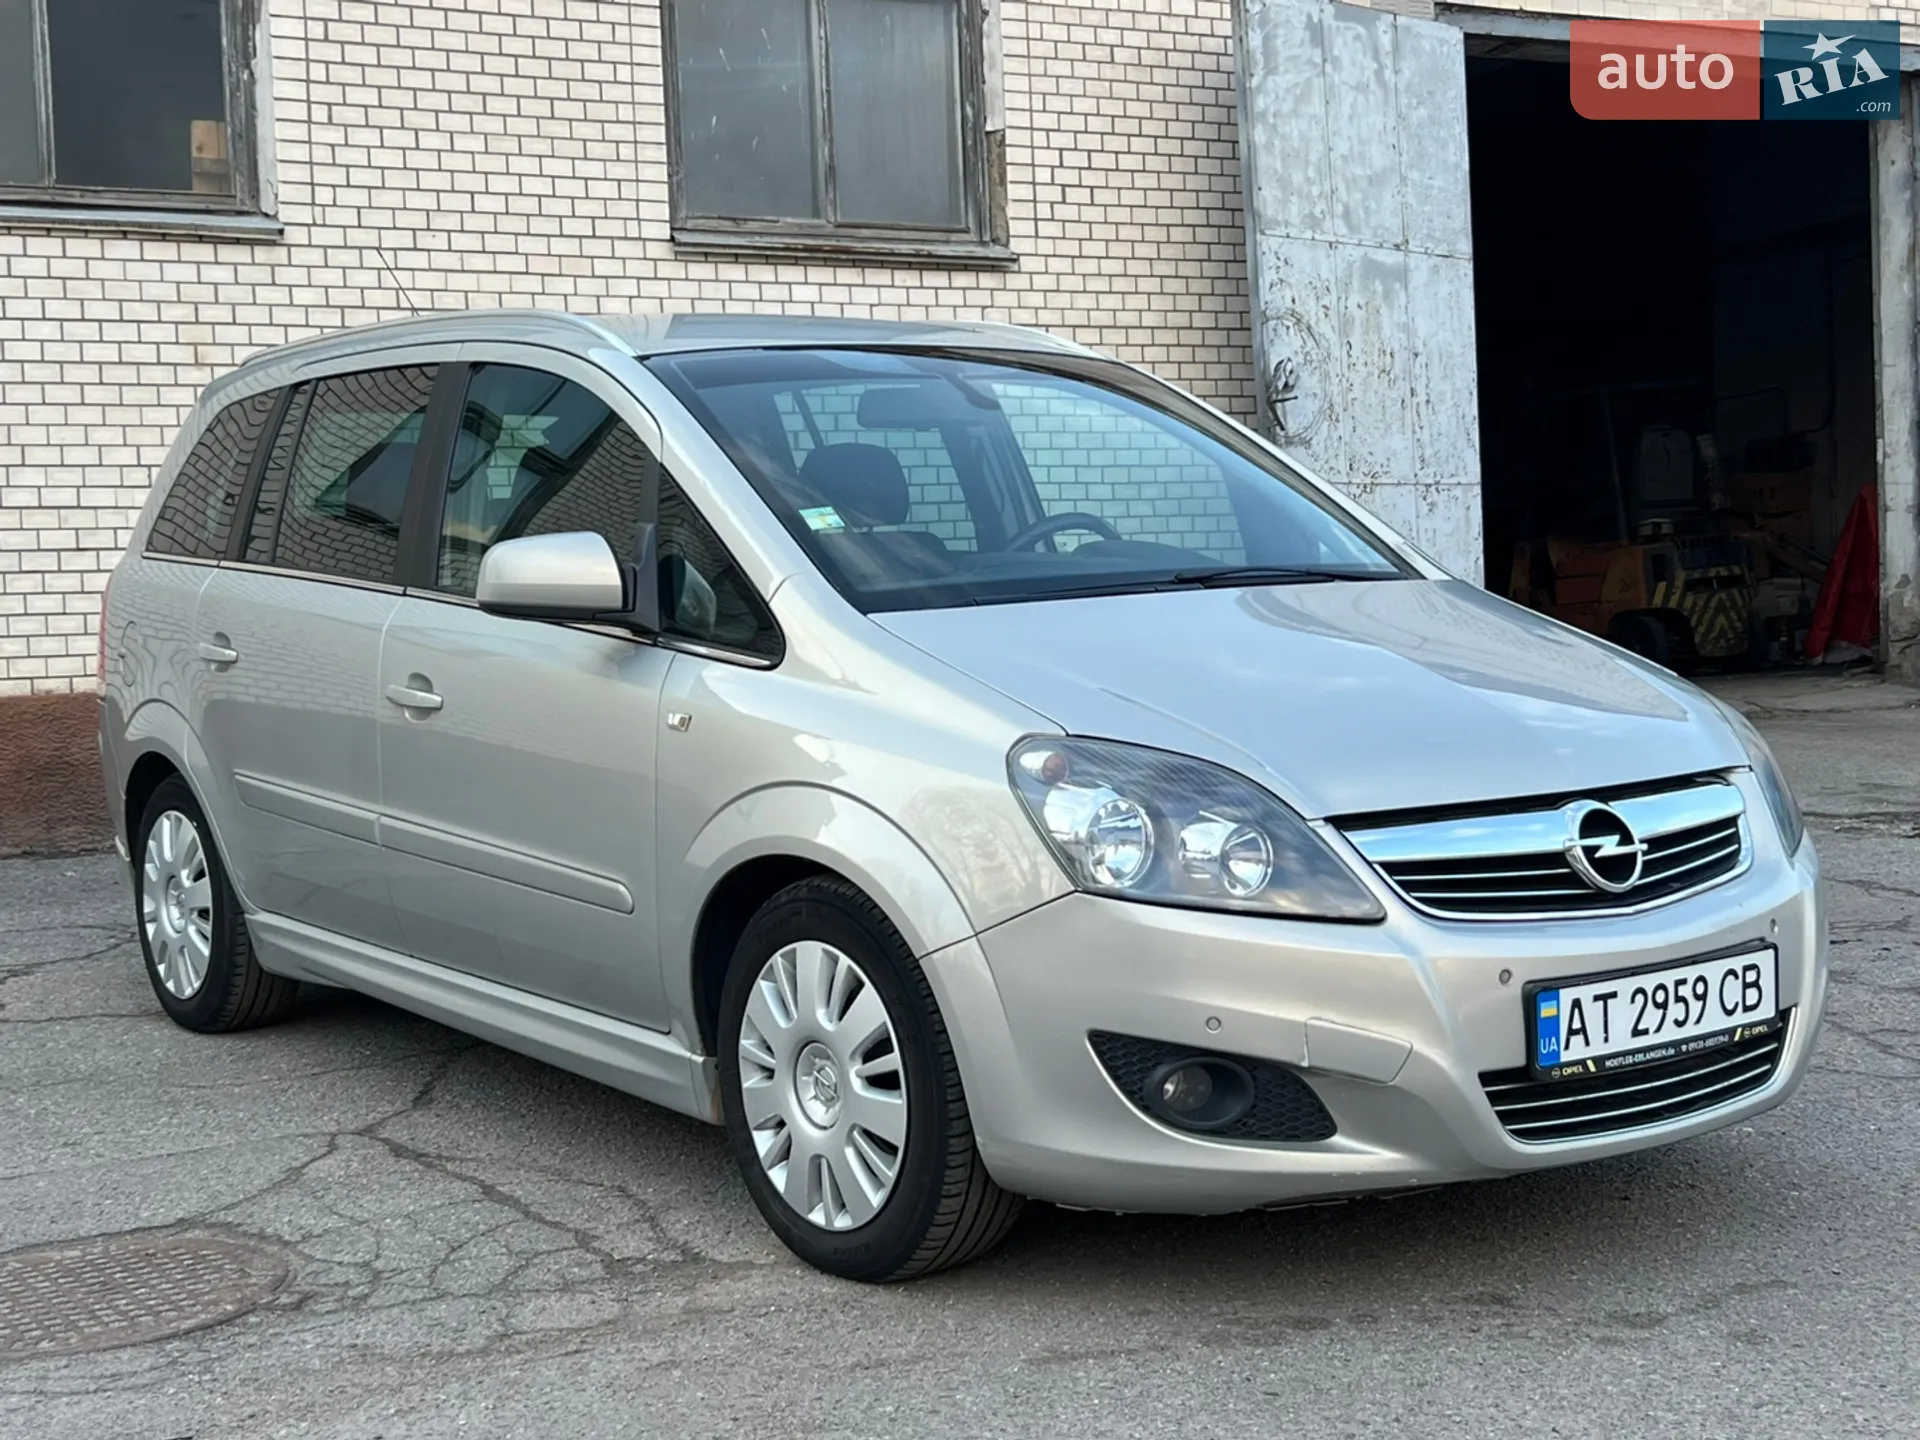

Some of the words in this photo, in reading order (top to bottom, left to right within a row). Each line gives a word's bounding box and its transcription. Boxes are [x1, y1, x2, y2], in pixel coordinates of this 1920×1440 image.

[1563, 990, 1618, 1051] AT
[1629, 974, 1709, 1039] 2959
[1719, 962, 1763, 1017] CB
[1540, 1036, 1559, 1054] UA
[1562, 1064, 1584, 1076] OPEL
